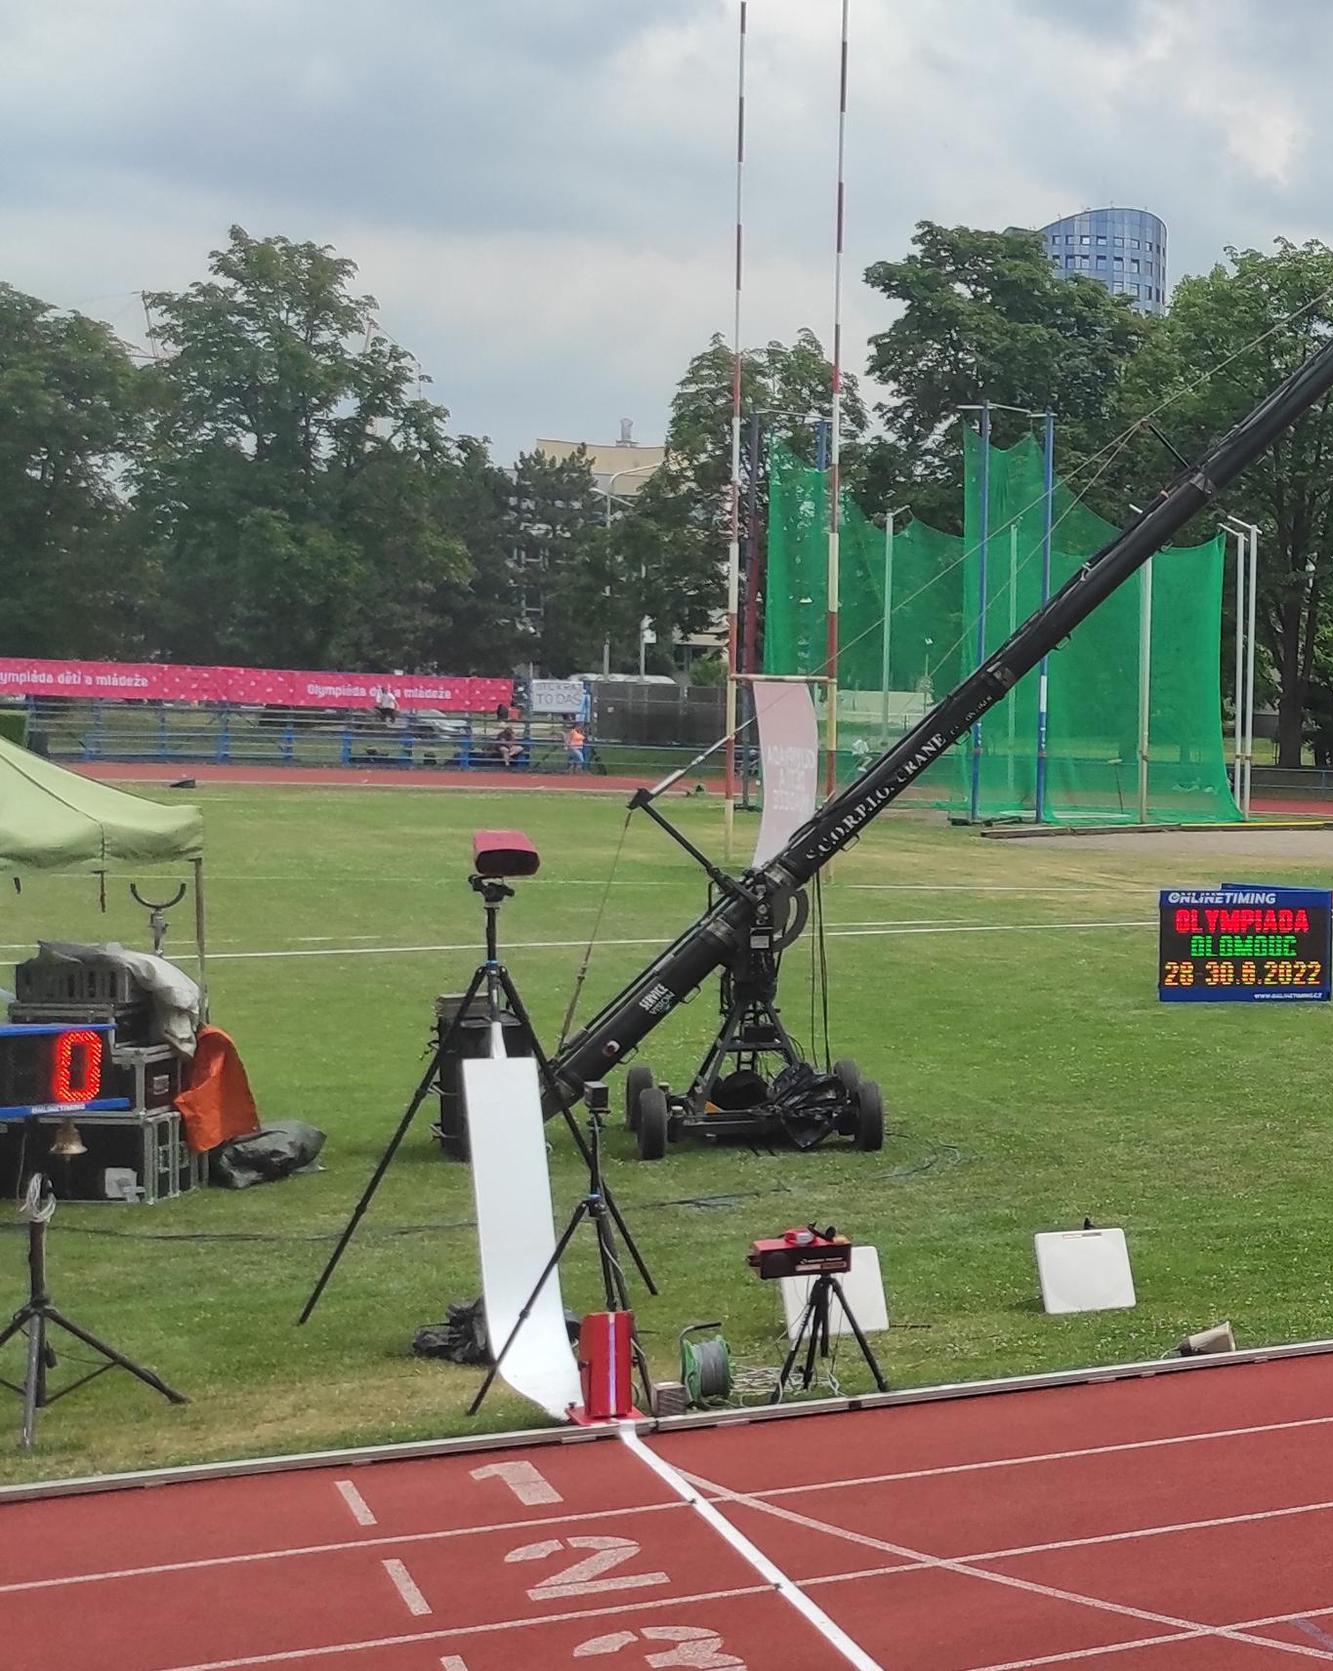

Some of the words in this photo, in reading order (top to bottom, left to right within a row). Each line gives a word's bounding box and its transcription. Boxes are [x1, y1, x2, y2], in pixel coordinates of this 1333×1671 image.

[0, 671, 53, 684] ympiáda
[896, 733, 947, 783] CRANE
[1168, 892, 1277, 904] ONLINETIMING
[1175, 909, 1310, 933] OLYMPIADA
[1190, 935, 1297, 957] OLOMOUC
[57, 1031, 102, 1102] 0
[468, 1460, 564, 1506] 1
[504, 1536, 671, 1601] 2
[572, 1626, 748, 1671] 3
